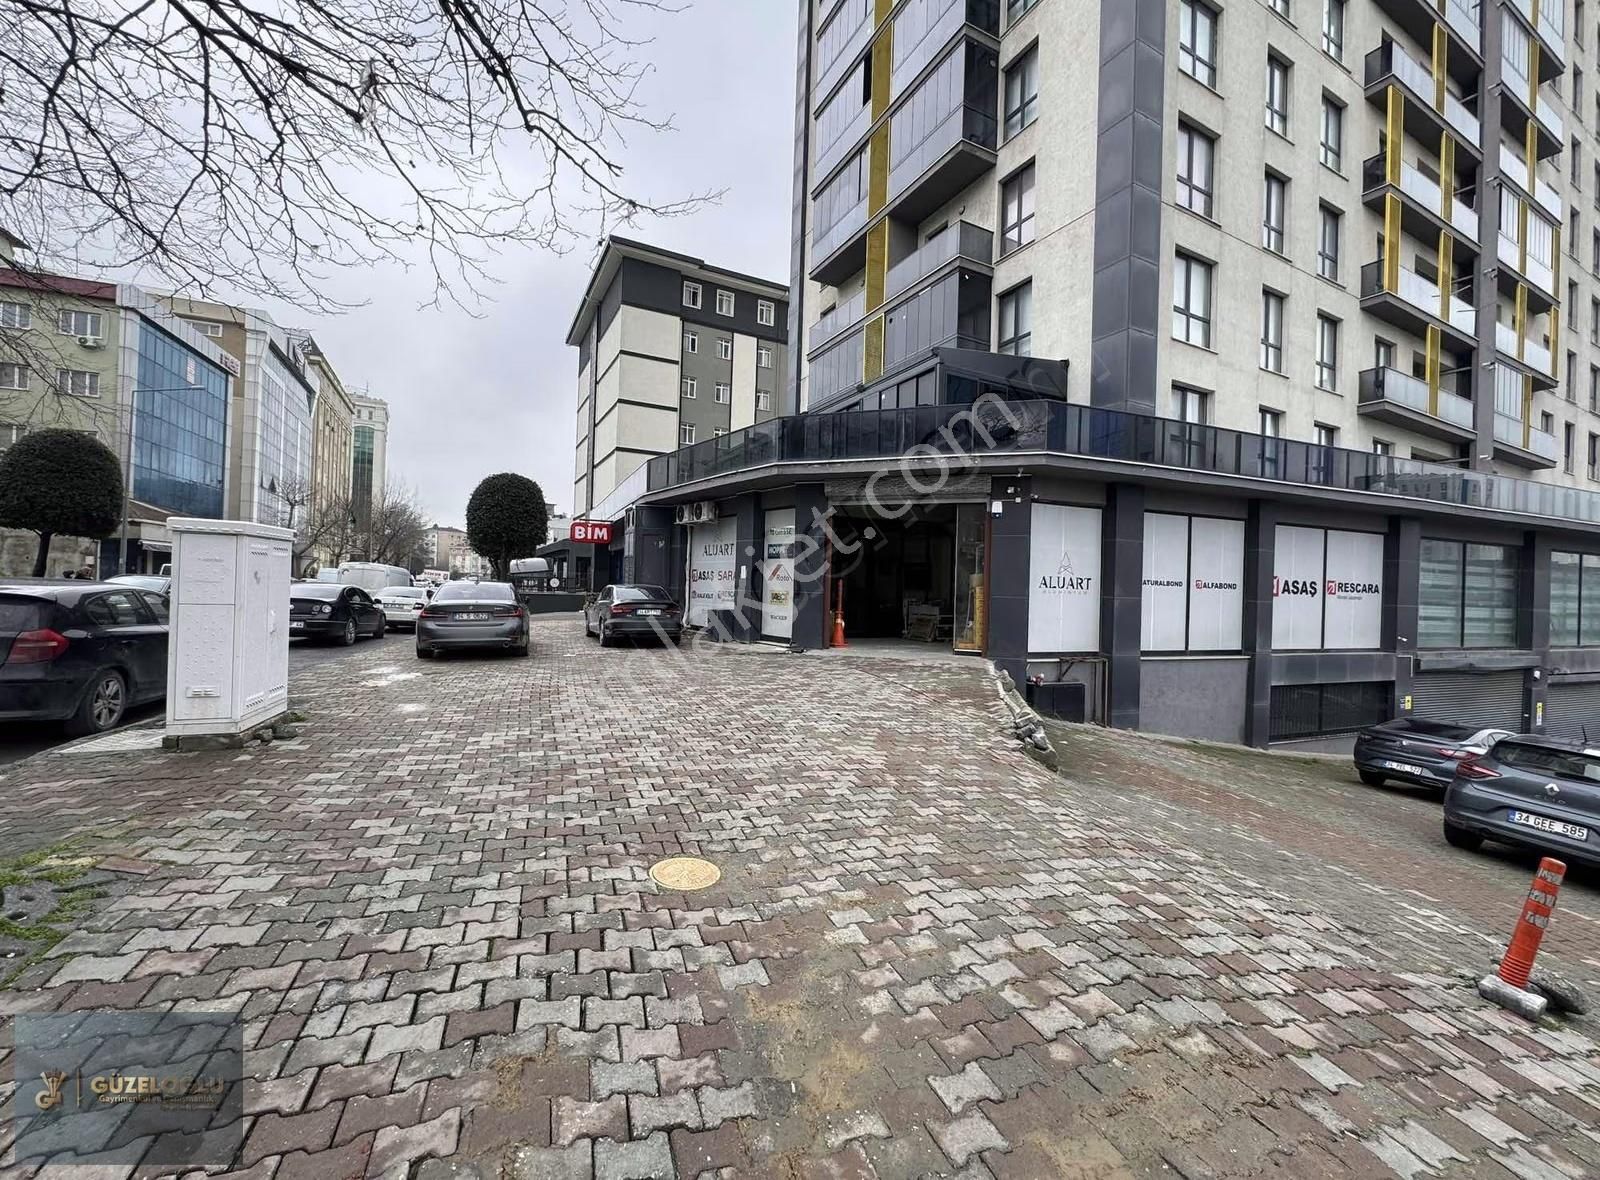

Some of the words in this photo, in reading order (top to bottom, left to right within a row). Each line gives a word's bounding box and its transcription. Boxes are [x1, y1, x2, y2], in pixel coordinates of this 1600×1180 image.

[574, 523, 608, 540] BİM
[703, 543, 734, 556] ALUART
[1038, 575, 1093, 591] ALUART
[1202, 582, 1237, 590] ALFABOND
[1281, 579, 1317, 597] ASAŞ
[1337, 582, 1380, 594] RESCARA
[1516, 812, 1530, 823] 34
[1533, 817, 1556, 830] GEE
[1562, 823, 1585, 838] 585
